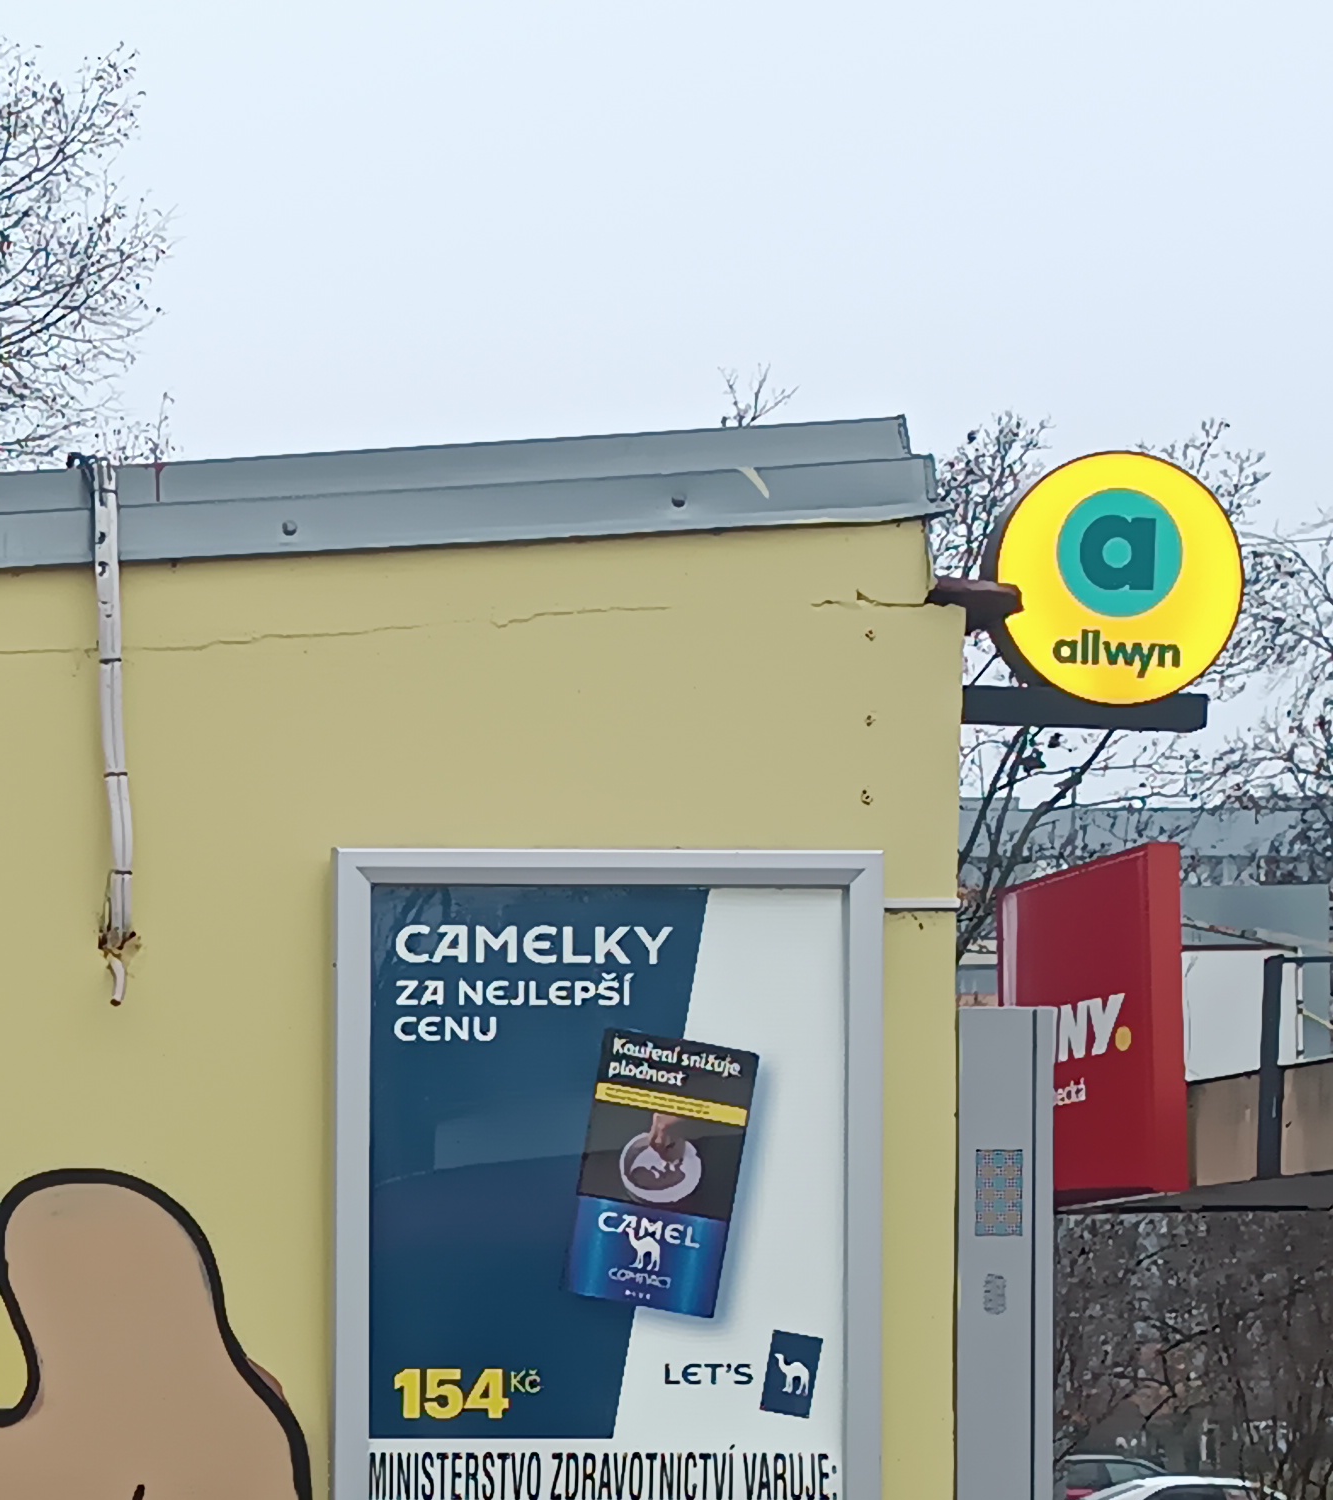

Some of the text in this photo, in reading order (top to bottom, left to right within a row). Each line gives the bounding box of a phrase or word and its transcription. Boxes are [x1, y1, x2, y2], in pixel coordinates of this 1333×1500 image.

[1079, 514, 1157, 591] a
[1052, 628, 1181, 679] allwyn
[395, 924, 673, 965] CAMELKY
[395, 972, 635, 1006] ZA NEJLEPŠÍ
[393, 1016, 497, 1042] CENU
[608, 1061, 686, 1087] plodnost
[598, 1211, 700, 1248] CAMEL
[393, 1368, 541, 1419] 154 Kč
